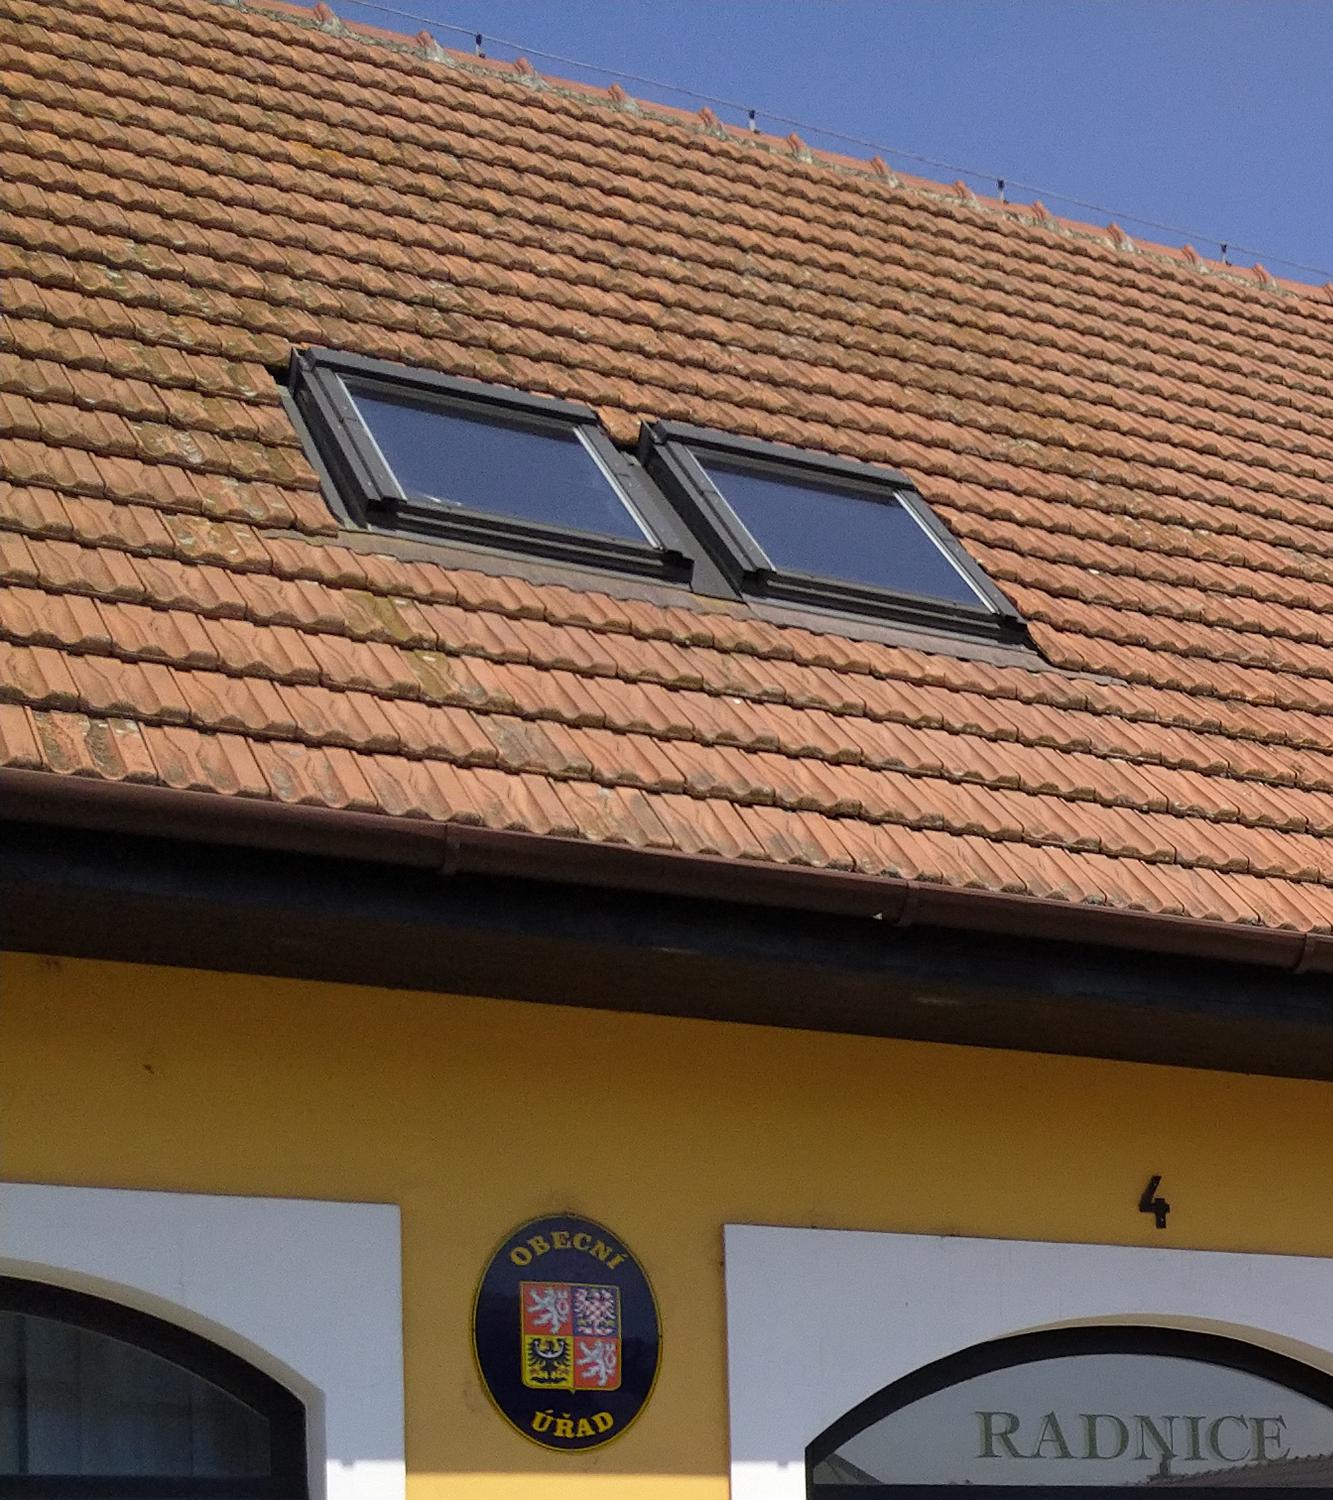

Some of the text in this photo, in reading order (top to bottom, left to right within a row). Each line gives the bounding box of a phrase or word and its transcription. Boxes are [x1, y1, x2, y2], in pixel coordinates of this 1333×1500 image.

[1138, 1175, 1170, 1229] 4
[510, 1231, 627, 1269] OBECNÍ
[531, 1408, 615, 1440] ÚŘAD
[974, 1410, 1292, 1462] RADNICE
